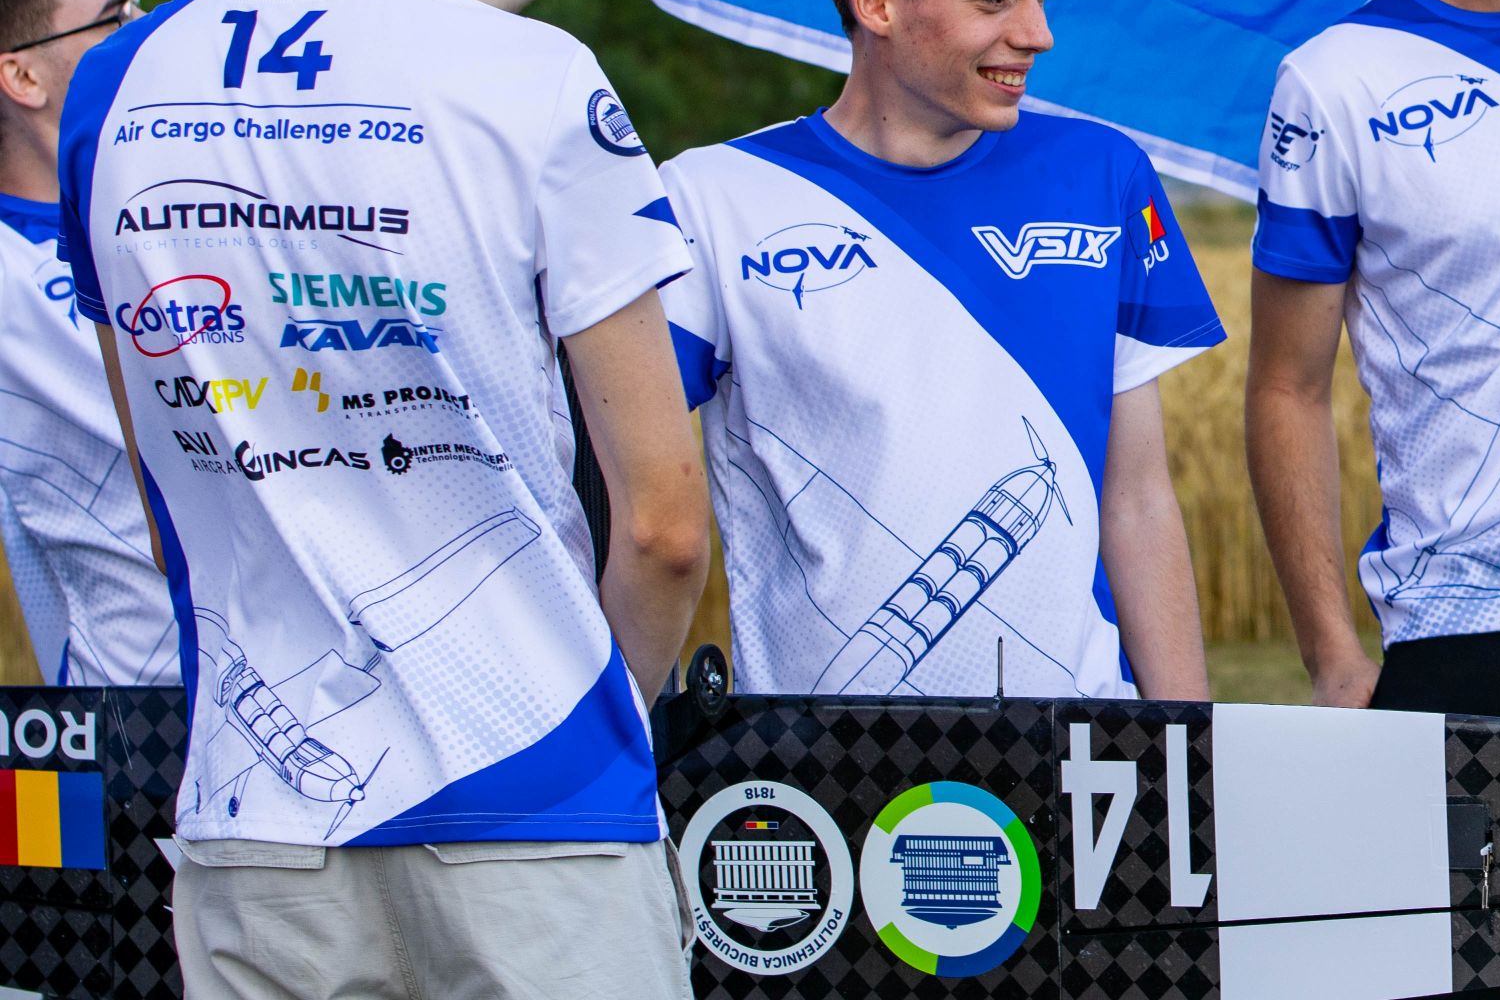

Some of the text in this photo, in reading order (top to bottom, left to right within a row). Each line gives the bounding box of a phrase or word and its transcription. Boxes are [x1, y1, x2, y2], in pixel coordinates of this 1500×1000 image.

[221, 9, 333, 90] 14
[114, 117, 425, 146] Air Cargo Challenge 2026
[1368, 87, 1500, 142] NOVA
[115, 202, 410, 236] AUTONOMOUS
[742, 243, 878, 281] NOVA
[971, 221, 1122, 280] VSIX
[268, 271, 448, 317] SIEMENS
[115, 299, 246, 337] Cotras
[342, 394, 376, 410] MS
[172, 430, 218, 456] AVI
[414, 444, 451, 457] INTER
[415, 454, 471, 464] Technologie
[191, 457, 242, 475] AIRCRAF
[0, 708, 97, 761] RO
[744, 786, 776, 800] 1818
[1060, 722, 1213, 910] 14
[763, 908, 844, 969] POLITEHNICA
